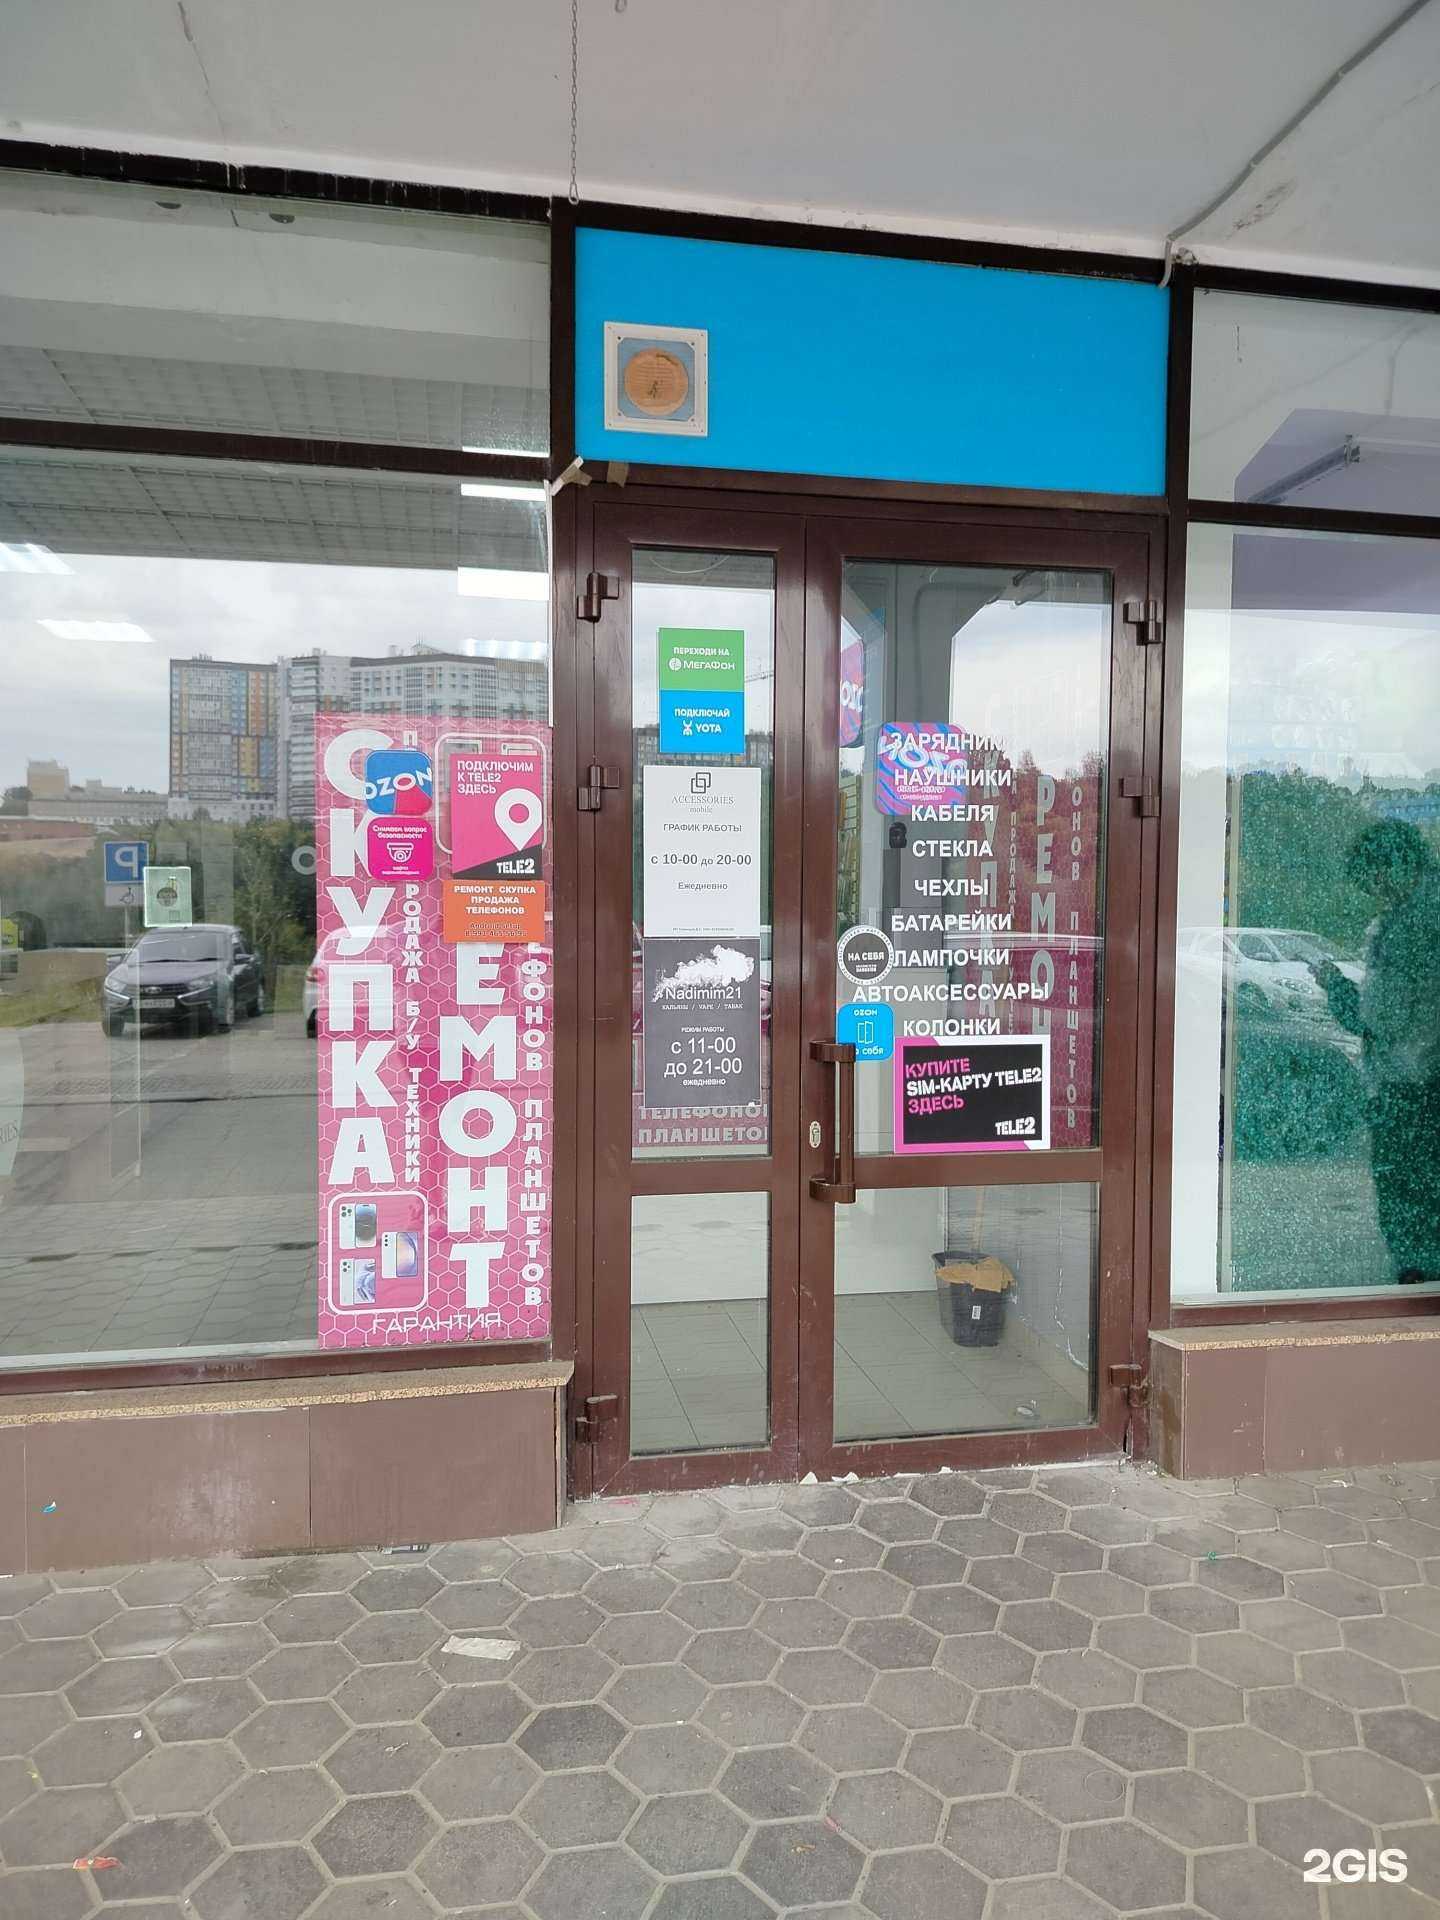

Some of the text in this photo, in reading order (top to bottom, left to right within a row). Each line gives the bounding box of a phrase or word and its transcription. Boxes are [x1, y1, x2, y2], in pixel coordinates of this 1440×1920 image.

[673, 647, 730, 656] ПЕРЕХОДИ НА
[674, 708, 731, 718] ПОДКЛЮЧАЙ
[695, 723, 722, 733] YOTA
[456, 760, 534, 772] ПОДКЛЮЧИМ
[456, 772, 502, 783] К TELE2
[894, 769, 1012, 787] НАУШНИКИ
[457, 784, 497, 795] ЗДЕСЬ
[671, 795, 735, 805] ACCESSORIES
[911, 804, 994, 822] КАБЕЛЯ
[663, 823, 742, 832] ГРАФИК РАБОТЫ
[912, 840, 993, 858] СТЕКЛА
[496, 858, 535, 874] TELE2
[662, 853, 698, 865] 10-00
[700, 858, 714, 868] до
[716, 854, 752, 865] 20-00
[454, 885, 537, 894] РЕМОНТ СКУПКА
[677, 881, 728, 891] Ежедневно
[914, 879, 989, 897] ЧЕХЛЫ
[471, 896, 520, 905] ПРОДАЖА
[1030, 774, 1056, 1035] РЕМОН
[465, 906, 526, 915] ТЕЛЕФОНОВ
[891, 910, 1013, 932] БАТАРЕЙКИ
[402, 884, 422, 983] РОДАЖА
[847, 951, 885, 961] НА СЕБЯ
[893, 949, 1010, 967] ЛАМПОЧКИ
[665, 986, 742, 1000] Nadimim21
[852, 982, 1049, 1003] АВТОАКСЕССУАРЫ
[903, 1018, 1001, 1036] КОЛОНКИ
[687, 1036, 736, 1054] 11-00
[663, 1057, 743, 1078] до 21-00
[905, 1057, 971, 1079] КУПИТЕ
[682, 1078, 727, 1086] ежедневно
[906, 1067, 1043, 1096] SIM-КАРТУ TELE2
[639, 1104, 768, 1120] ТЕЛЕФОНО
[908, 1094, 965, 1116] ЗДЕСЬ
[404, 1067, 422, 1183] ТЕХНИКИ
[438, 942, 518, 1309] ЕМОНТ
[995, 1116, 1036, 1136] TELE2
[639, 1126, 768, 1144] ПЛАНШЕТО
[520, 1099, 547, 1306] ПЛАНШЕТОВ
[372, 1312, 501, 1335] ГАРАНТИЯ
